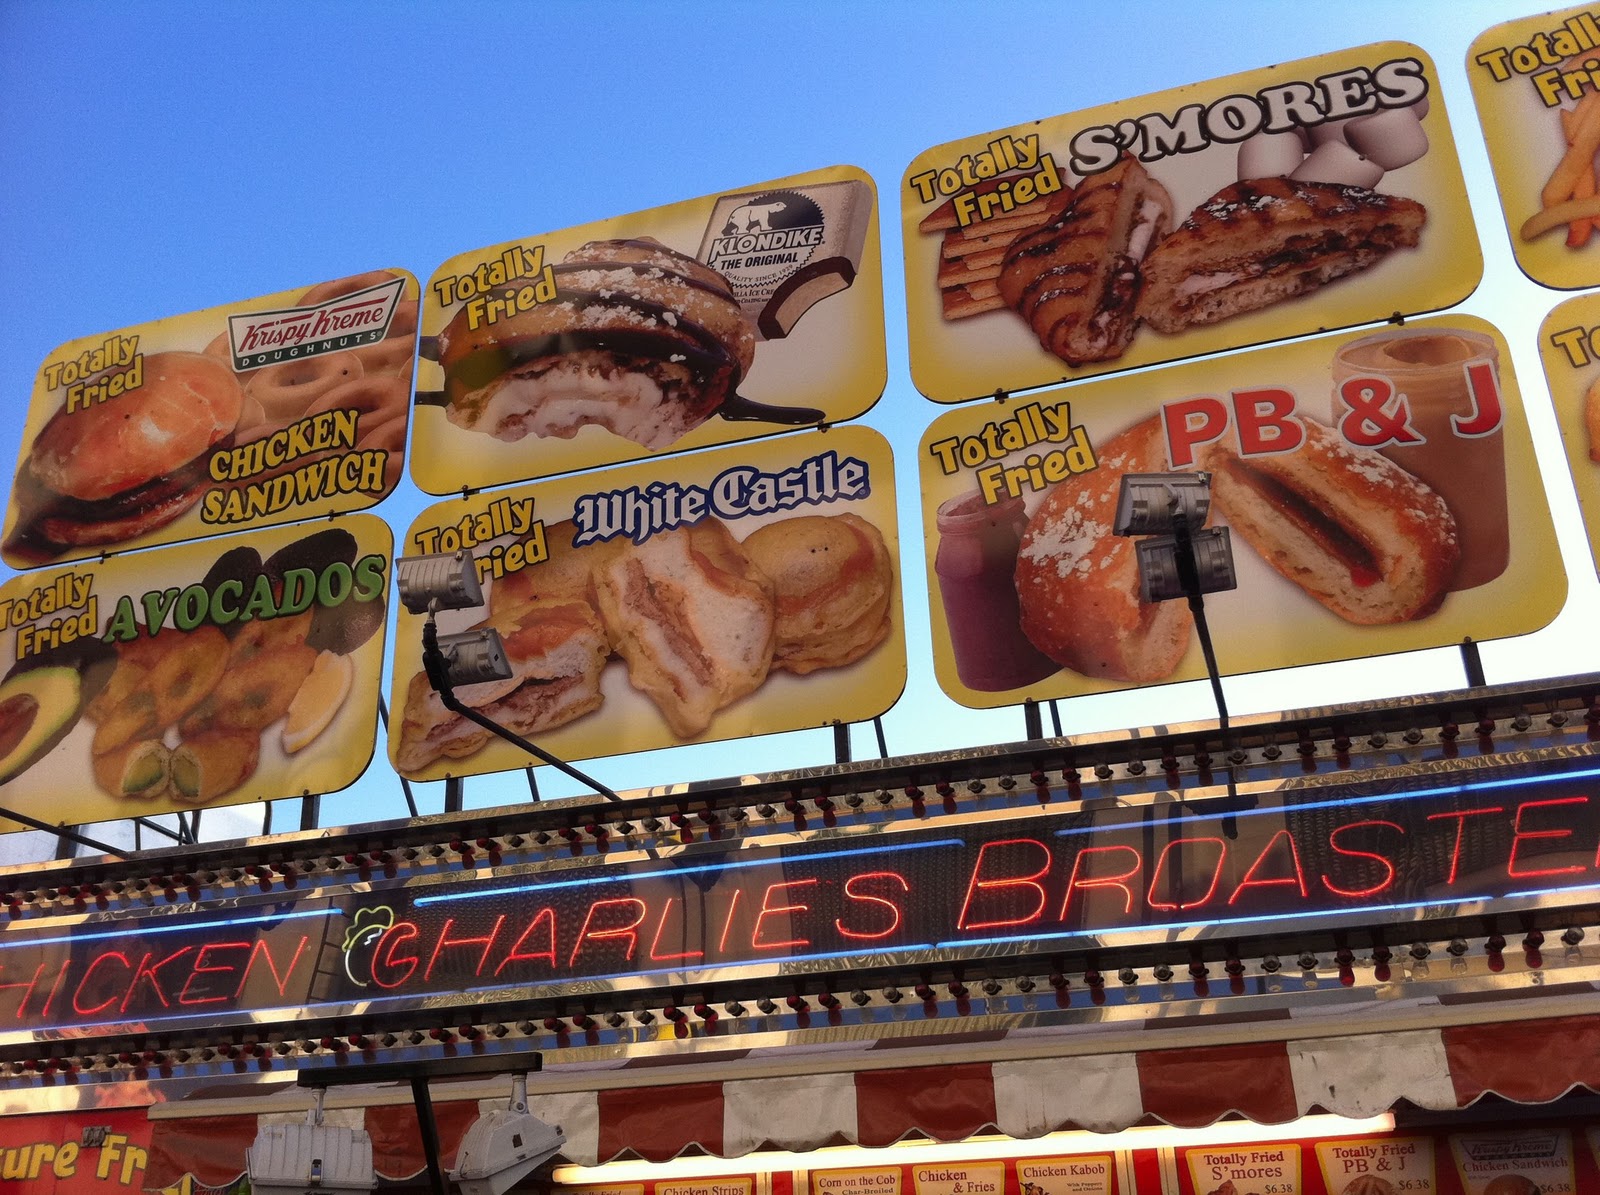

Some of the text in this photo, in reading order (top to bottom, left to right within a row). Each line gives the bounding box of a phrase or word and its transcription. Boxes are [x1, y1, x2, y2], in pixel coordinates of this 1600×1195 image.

[1475, 12, 1600, 83] Totall
[1068, 57, 1430, 176] S'MORES
[911, 133, 1041, 203] Totally
[952, 153, 1063, 229] Fried
[707, 226, 825, 266] KLONDIKE
[720, 252, 799, 271] THE ORIGINAL
[434, 245, 545, 307] Totally
[466, 265, 558, 331] Fried
[724, 271, 754, 283] QUALITY
[755, 272, 778, 282] SINCE
[238, 295, 390, 352] Krispy Kreme
[242, 331, 377, 367] DOUGHNUTS
[44, 335, 140, 392] Totally
[66, 355, 144, 414] Fried
[930, 400, 1072, 476] Totally
[1160, 359, 1504, 471] PB & J
[207, 408, 360, 482] CHICKEN
[976, 425, 1098, 505] Fried
[201, 450, 389, 524] SANDWICH
[572, 450, 872, 547] White Castle
[415, 497, 535, 556] Totally
[474, 519, 550, 585] ried
[16, 594, 98, 661] Fried
[101, 554, 386, 644] AVOCADOS
[956, 796, 1600, 930] BROASTE
[0, 1141, 80, 1181] ure
[918, 1169, 968, 1182] Chicken
[1023, 1163, 1105, 1178] Chicken Kabob
[1204, 1150, 1285, 1167] Totally Fried
[1211, 1165, 1283, 1181] S'mores
[1332, 1143, 1416, 1159] Totally Fried
[1343, 1156, 1406, 1174] PB & J
[1462, 1156, 1569, 1173] Chicken Sandwich
[818, 1174, 896, 1188] Corn on the Cob
[841, 1187, 895, 1195] Char-Broiled
[952, 1181, 996, 1194] & Fries
[1264, 1183, 1294, 1194] $6.38
[1398, 1179, 1431, 1191] $6.38
[1541, 1182, 1572, 1194] $6.38
